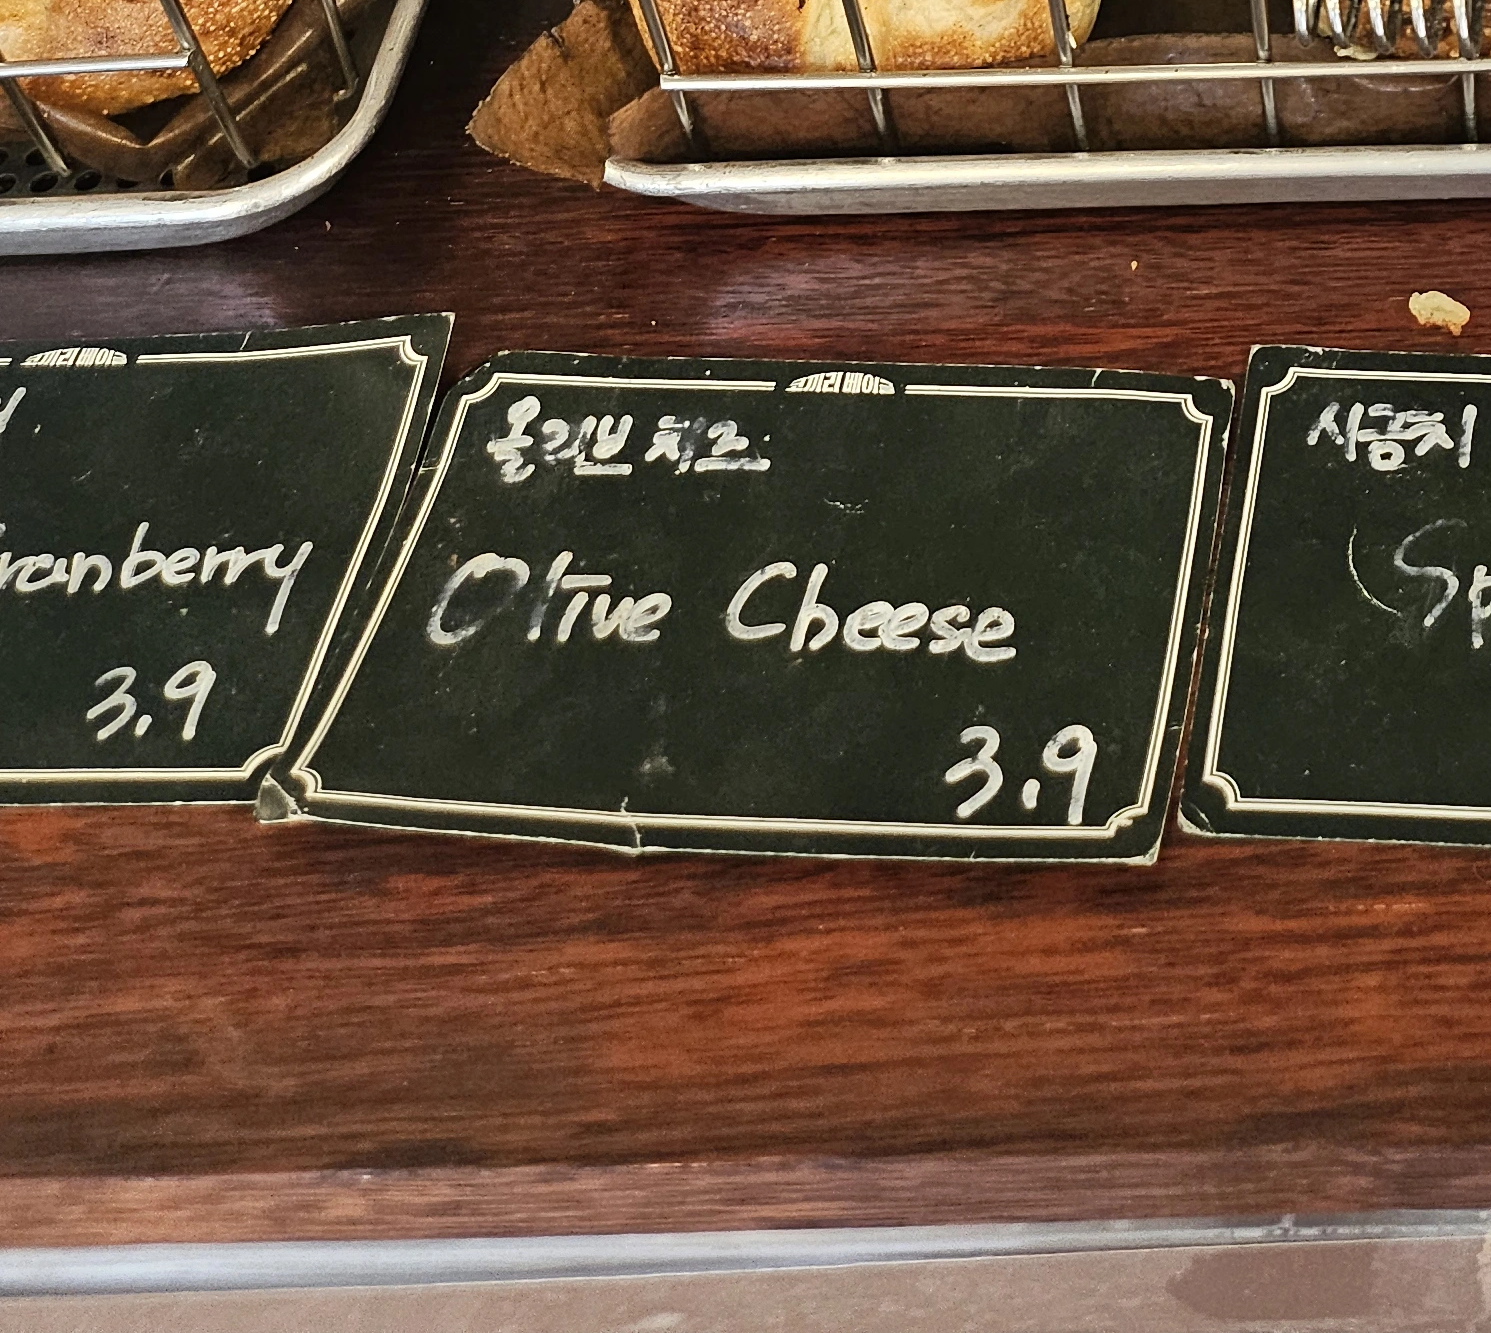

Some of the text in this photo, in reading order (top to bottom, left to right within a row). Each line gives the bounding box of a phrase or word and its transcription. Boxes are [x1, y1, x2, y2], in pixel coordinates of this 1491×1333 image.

[0, 521, 314, 636] ranberry
[425, 550, 1019, 664] Olive Cheese
[86, 658, 217, 741] 3.9
[943, 723, 1099, 826] 3.9
